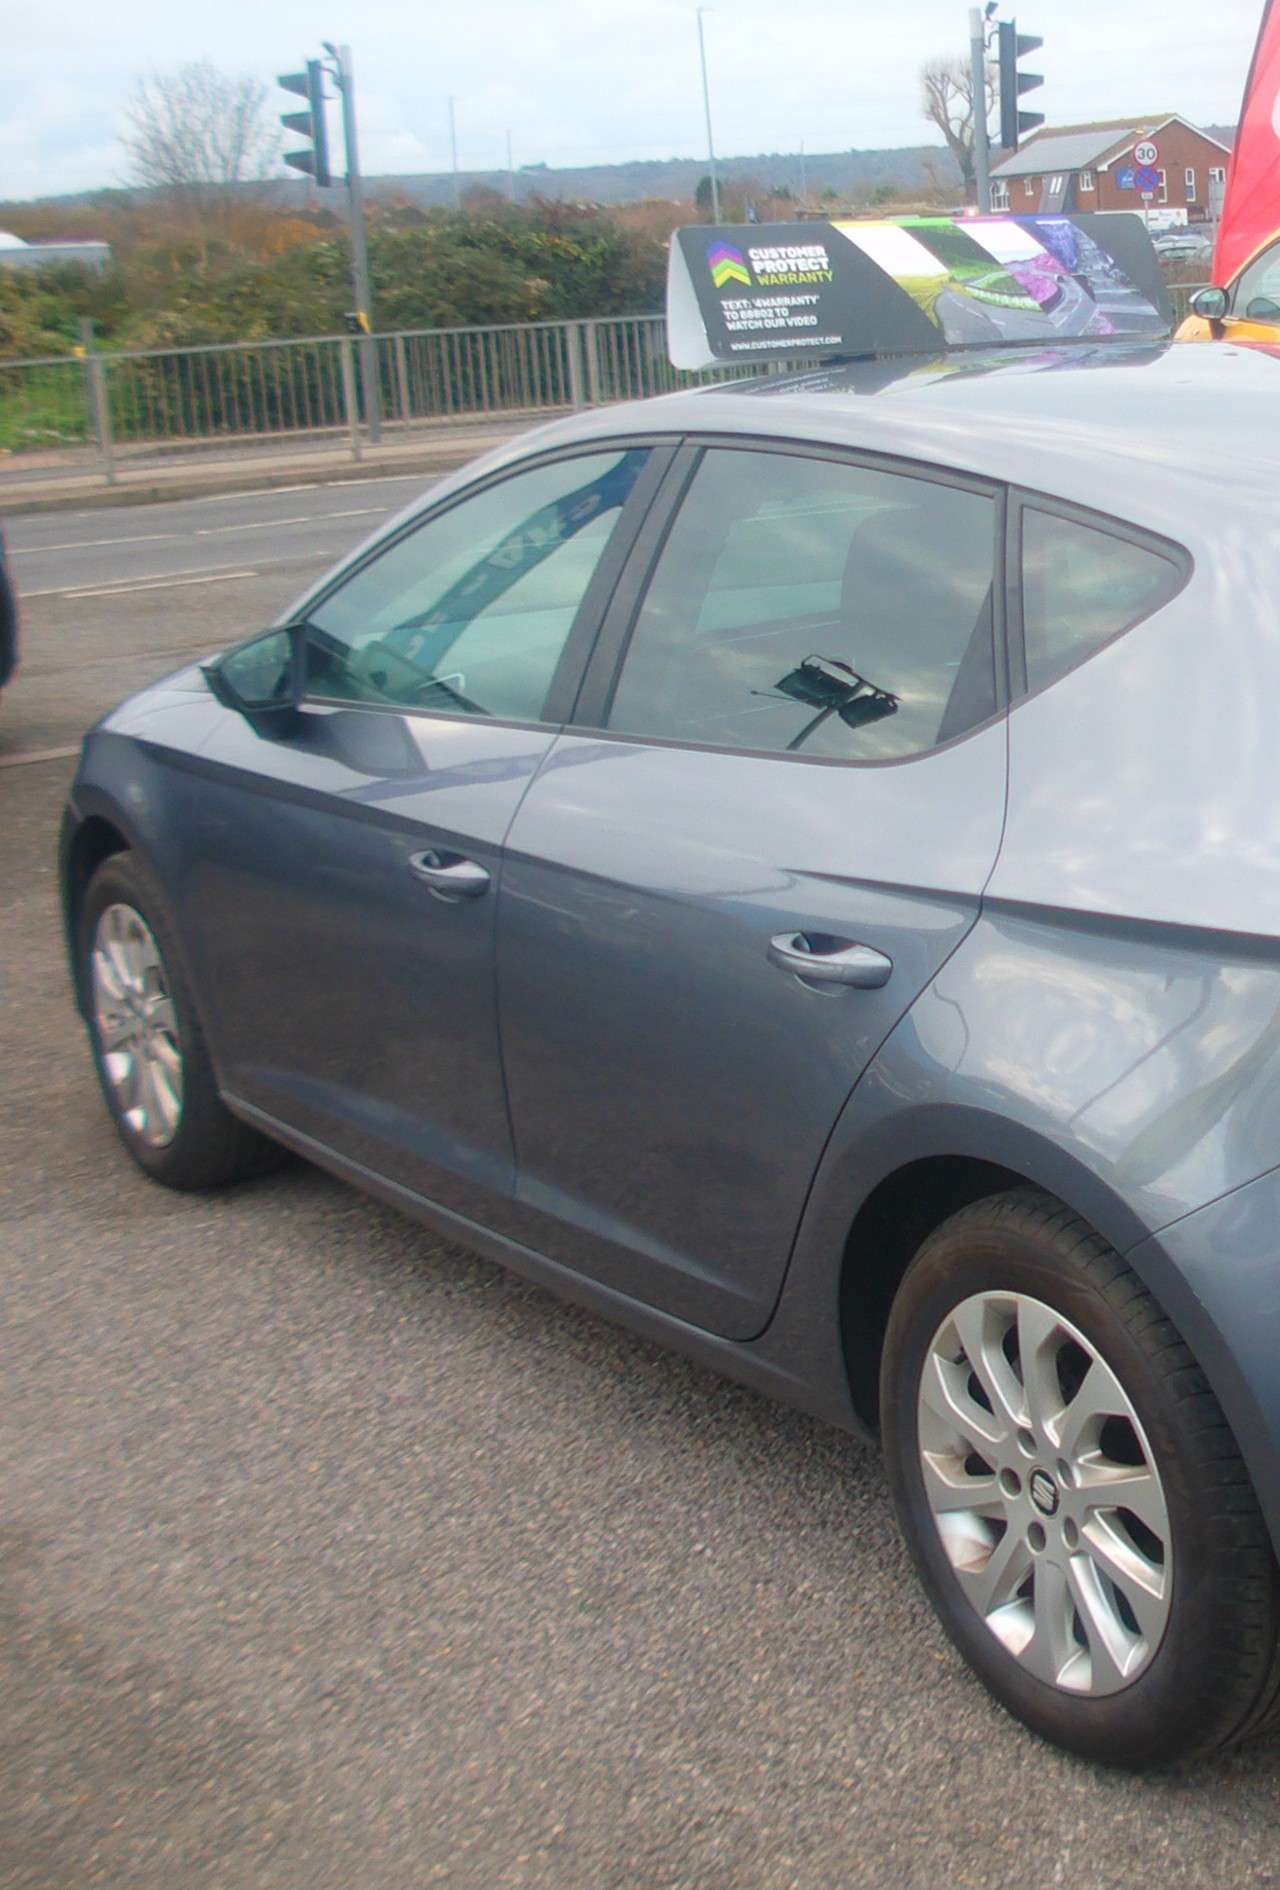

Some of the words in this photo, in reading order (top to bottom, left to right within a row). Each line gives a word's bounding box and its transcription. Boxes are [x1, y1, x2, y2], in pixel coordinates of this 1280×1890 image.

[1138, 147, 1155, 160] 30
[748, 245, 827, 260] CUSTOMER
[751, 257, 829, 274] PROTECT
[757, 271, 833, 286] WARRANTY
[724, 311, 739, 320] TO
[775, 307, 789, 317] TO
[725, 320, 763, 331] WATCH
[764, 318, 786, 329] OUR
[787, 315, 818, 326] VIDEO
